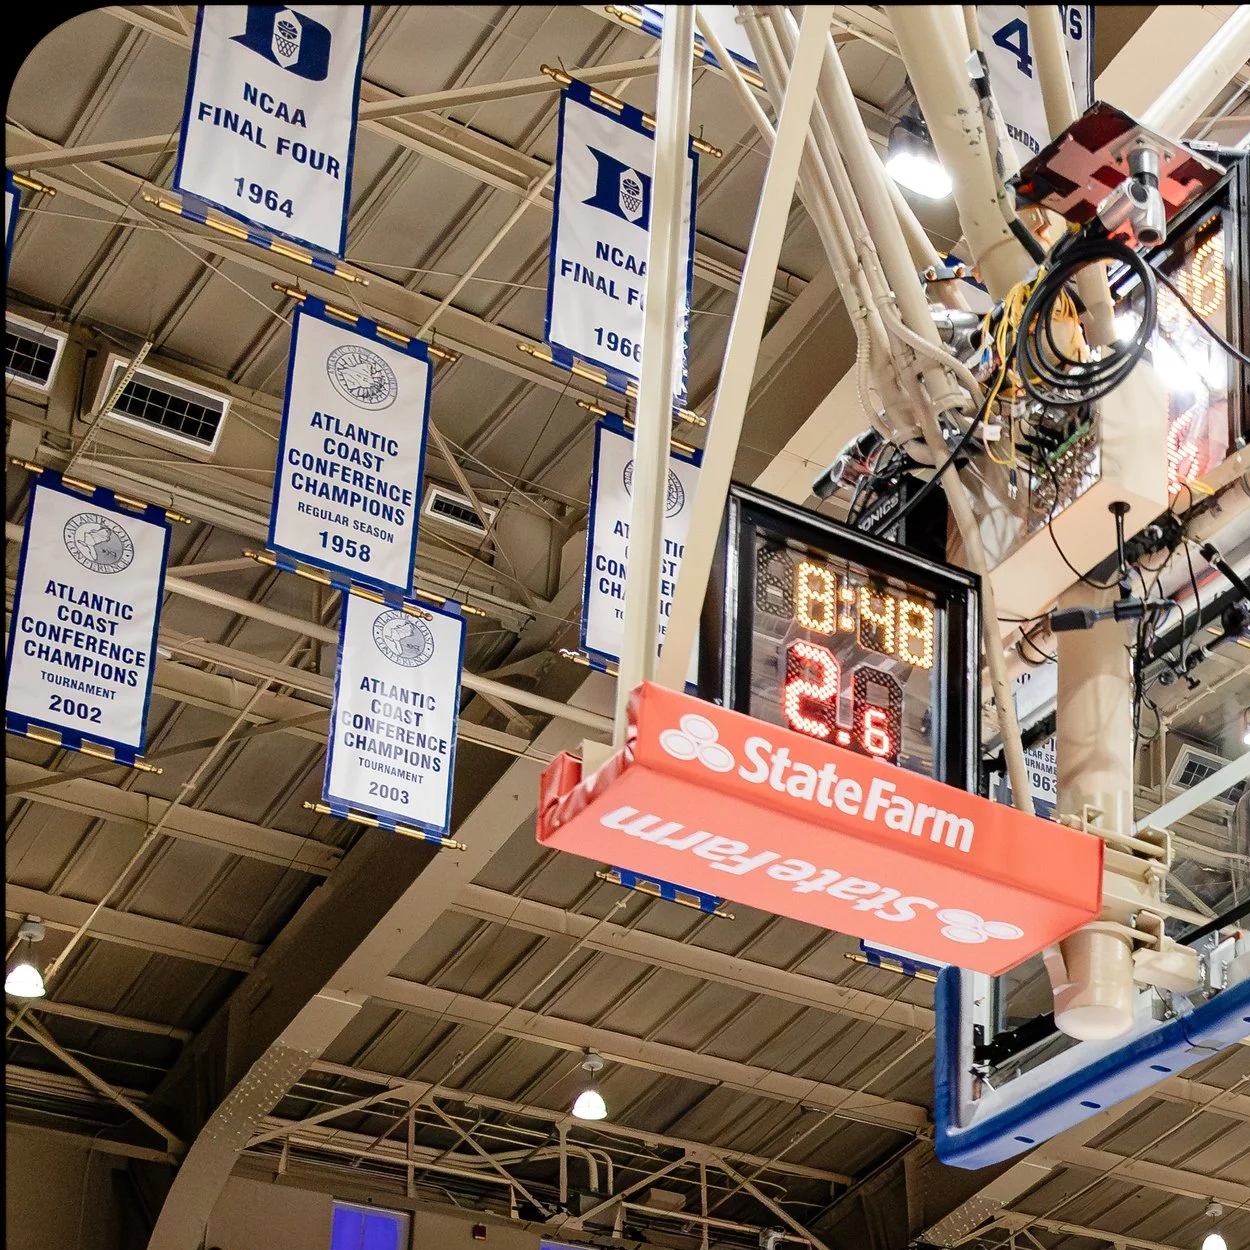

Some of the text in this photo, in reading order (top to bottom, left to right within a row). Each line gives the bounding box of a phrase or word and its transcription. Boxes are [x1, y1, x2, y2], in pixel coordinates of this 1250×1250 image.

[243, 81, 308, 129] NCAA
[197, 101, 341, 180] FINAL FOUR
[234, 176, 294, 219] 1964
[560, 258, 619, 300] FINAL
[311, 411, 399, 457] ATLANTIC
[323, 438, 385, 473] COAST
[288, 448, 413, 507] CONFERENCE
[291, 472, 406, 527] CHAMPIONS
[297, 502, 394, 544] REGULAR SEASON
[319, 530, 371, 564] 1958
[45, 579, 133, 621] ATLANTIC
[57, 605, 118, 637] COAST
[798, 561, 934, 670] 8:48
[21, 616, 146, 667] CONFERENCE
[24, 639, 138, 687] CHAMPIONS
[40, 670, 116, 701] TOURNAMENT
[360, 676, 436, 711] ATLANTIC
[785, 643, 890, 757] 2.6
[48, 694, 102, 724] 2002
[371, 699, 423, 727] COAST
[341, 710, 447, 755] CONFERENCE
[344, 732, 441, 772] CHAMPIONS
[358, 757, 424, 784] TOURNAMENT
[368, 781, 409, 804] 2003
